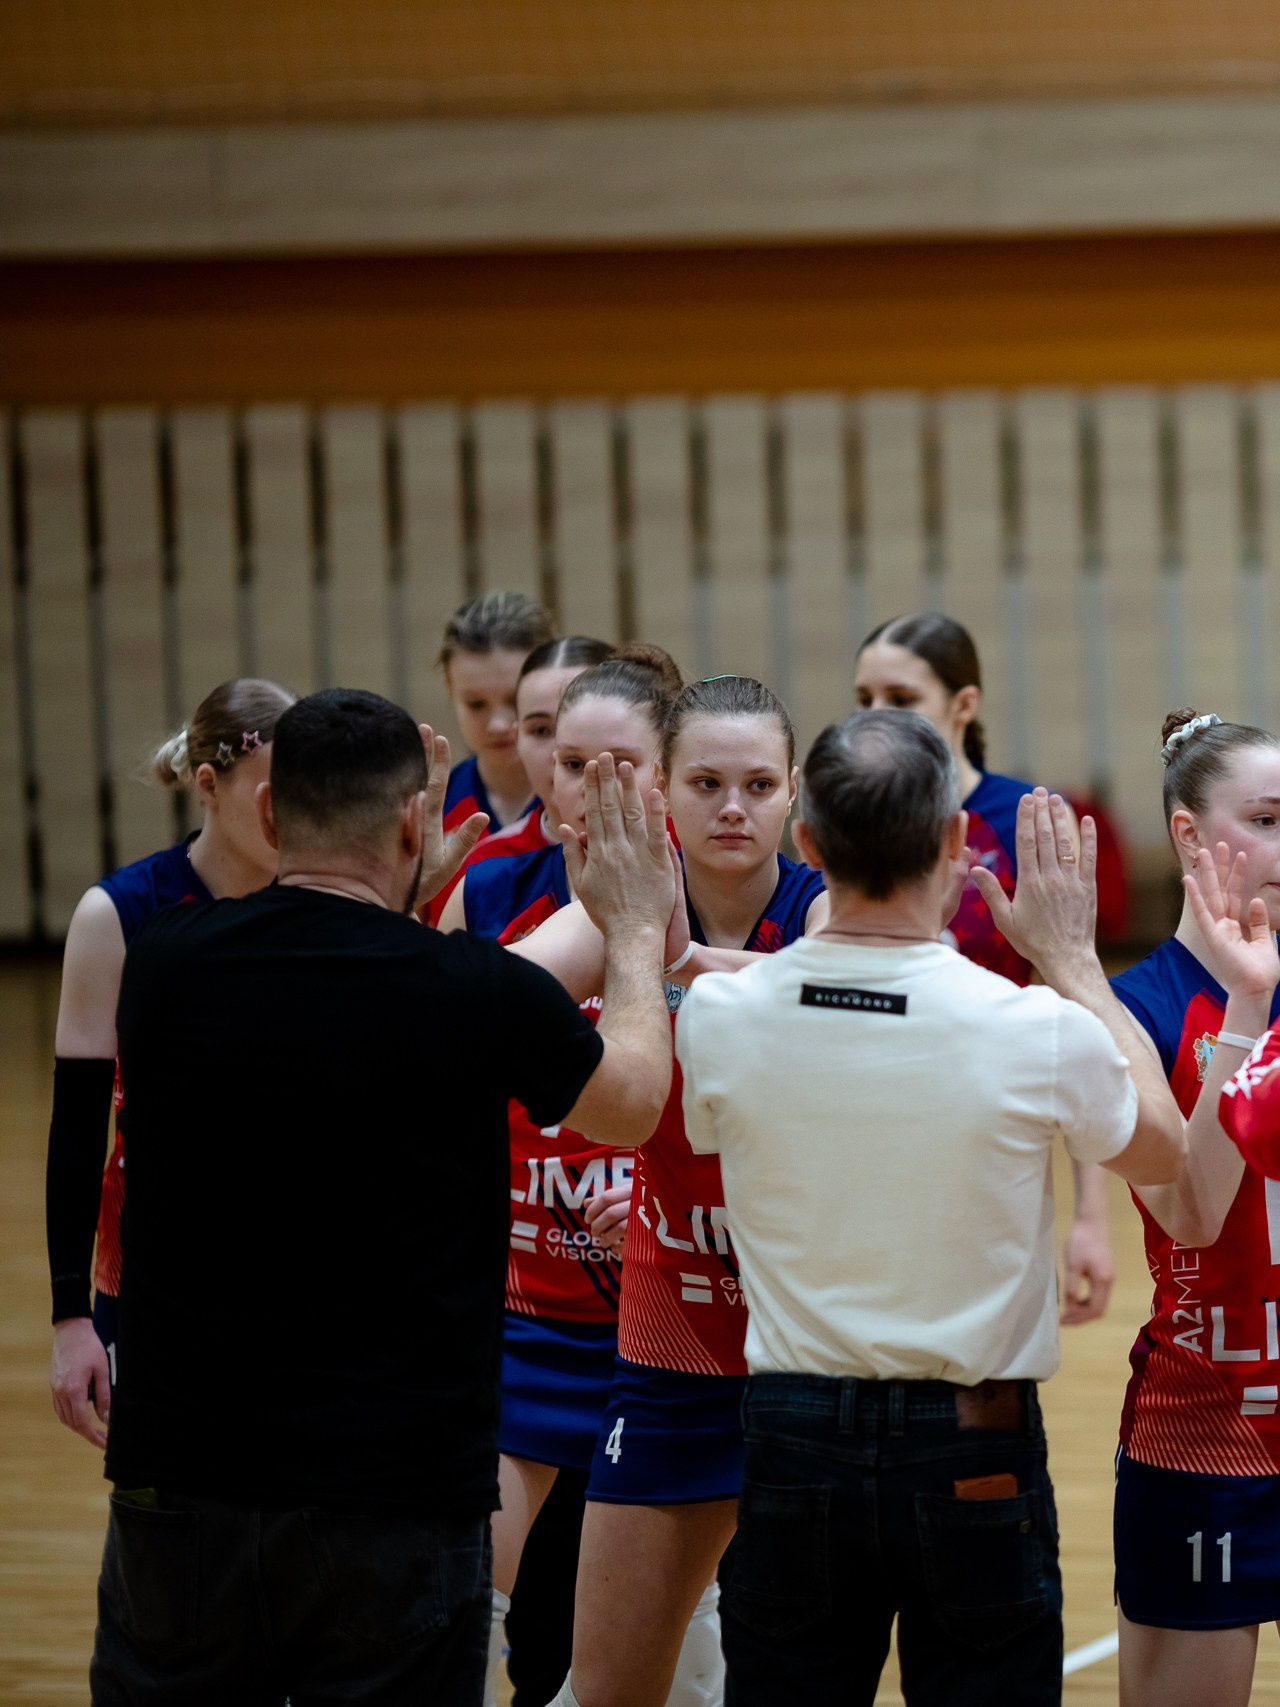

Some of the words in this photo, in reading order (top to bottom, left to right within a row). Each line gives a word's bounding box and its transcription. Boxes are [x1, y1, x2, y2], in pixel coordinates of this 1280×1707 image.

[544, 1242, 623, 1263] VISION
[605, 1417, 625, 1464] 4
[1186, 1531, 1232, 1583] 11
